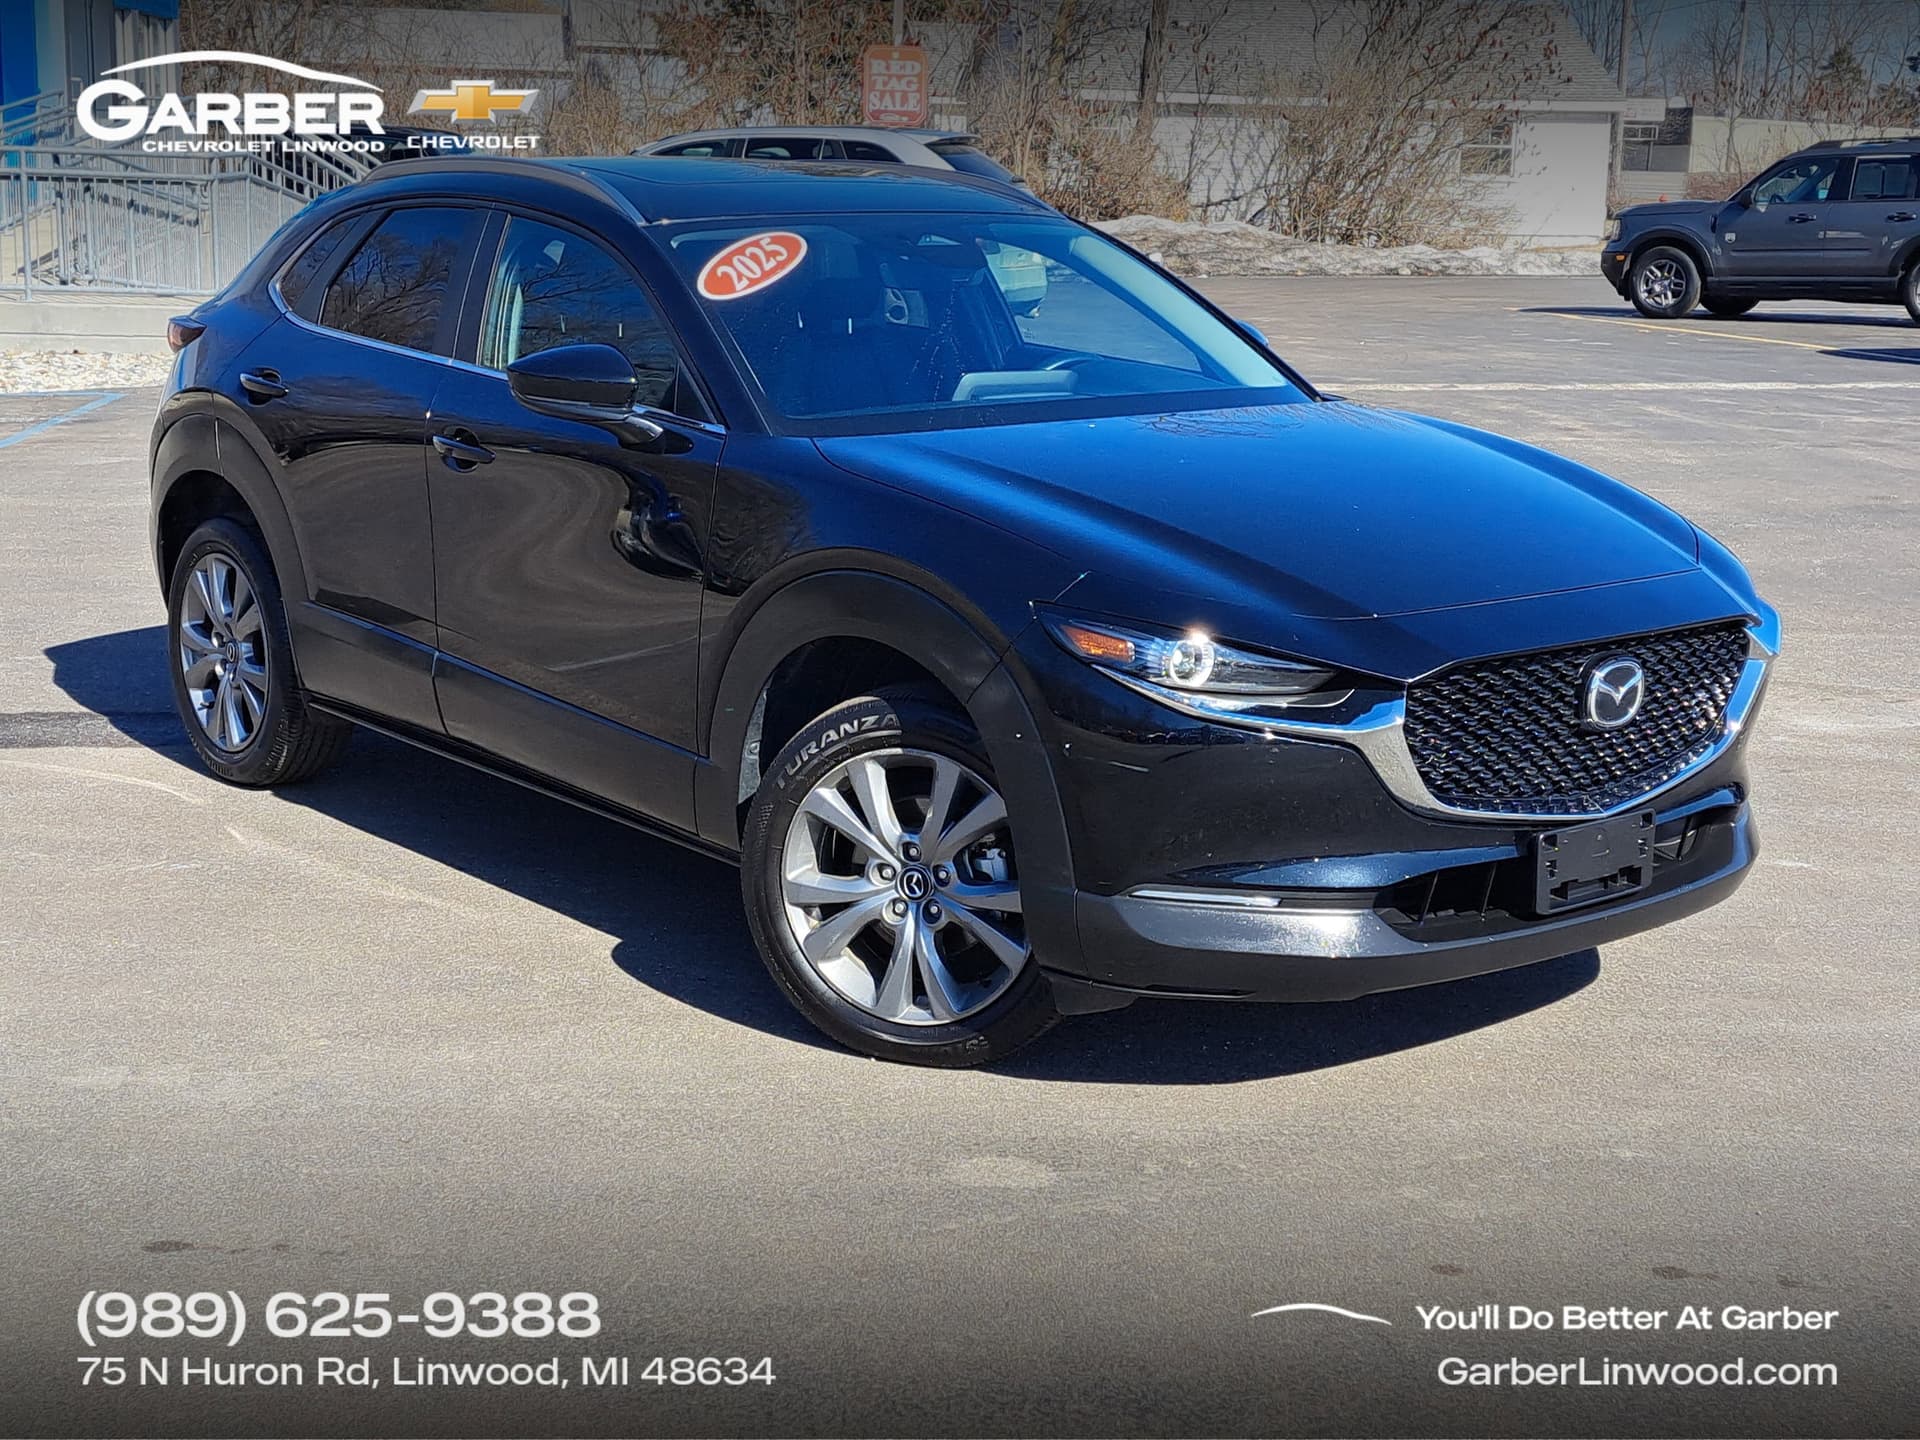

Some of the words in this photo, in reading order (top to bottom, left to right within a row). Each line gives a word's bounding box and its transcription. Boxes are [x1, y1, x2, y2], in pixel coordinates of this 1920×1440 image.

[870, 60, 921, 75] RED
[871, 76, 918, 91] TAG
[869, 91, 921, 111] SALE
[716, 237, 788, 291] 2025
[777, 713, 901, 789] TURANZA
